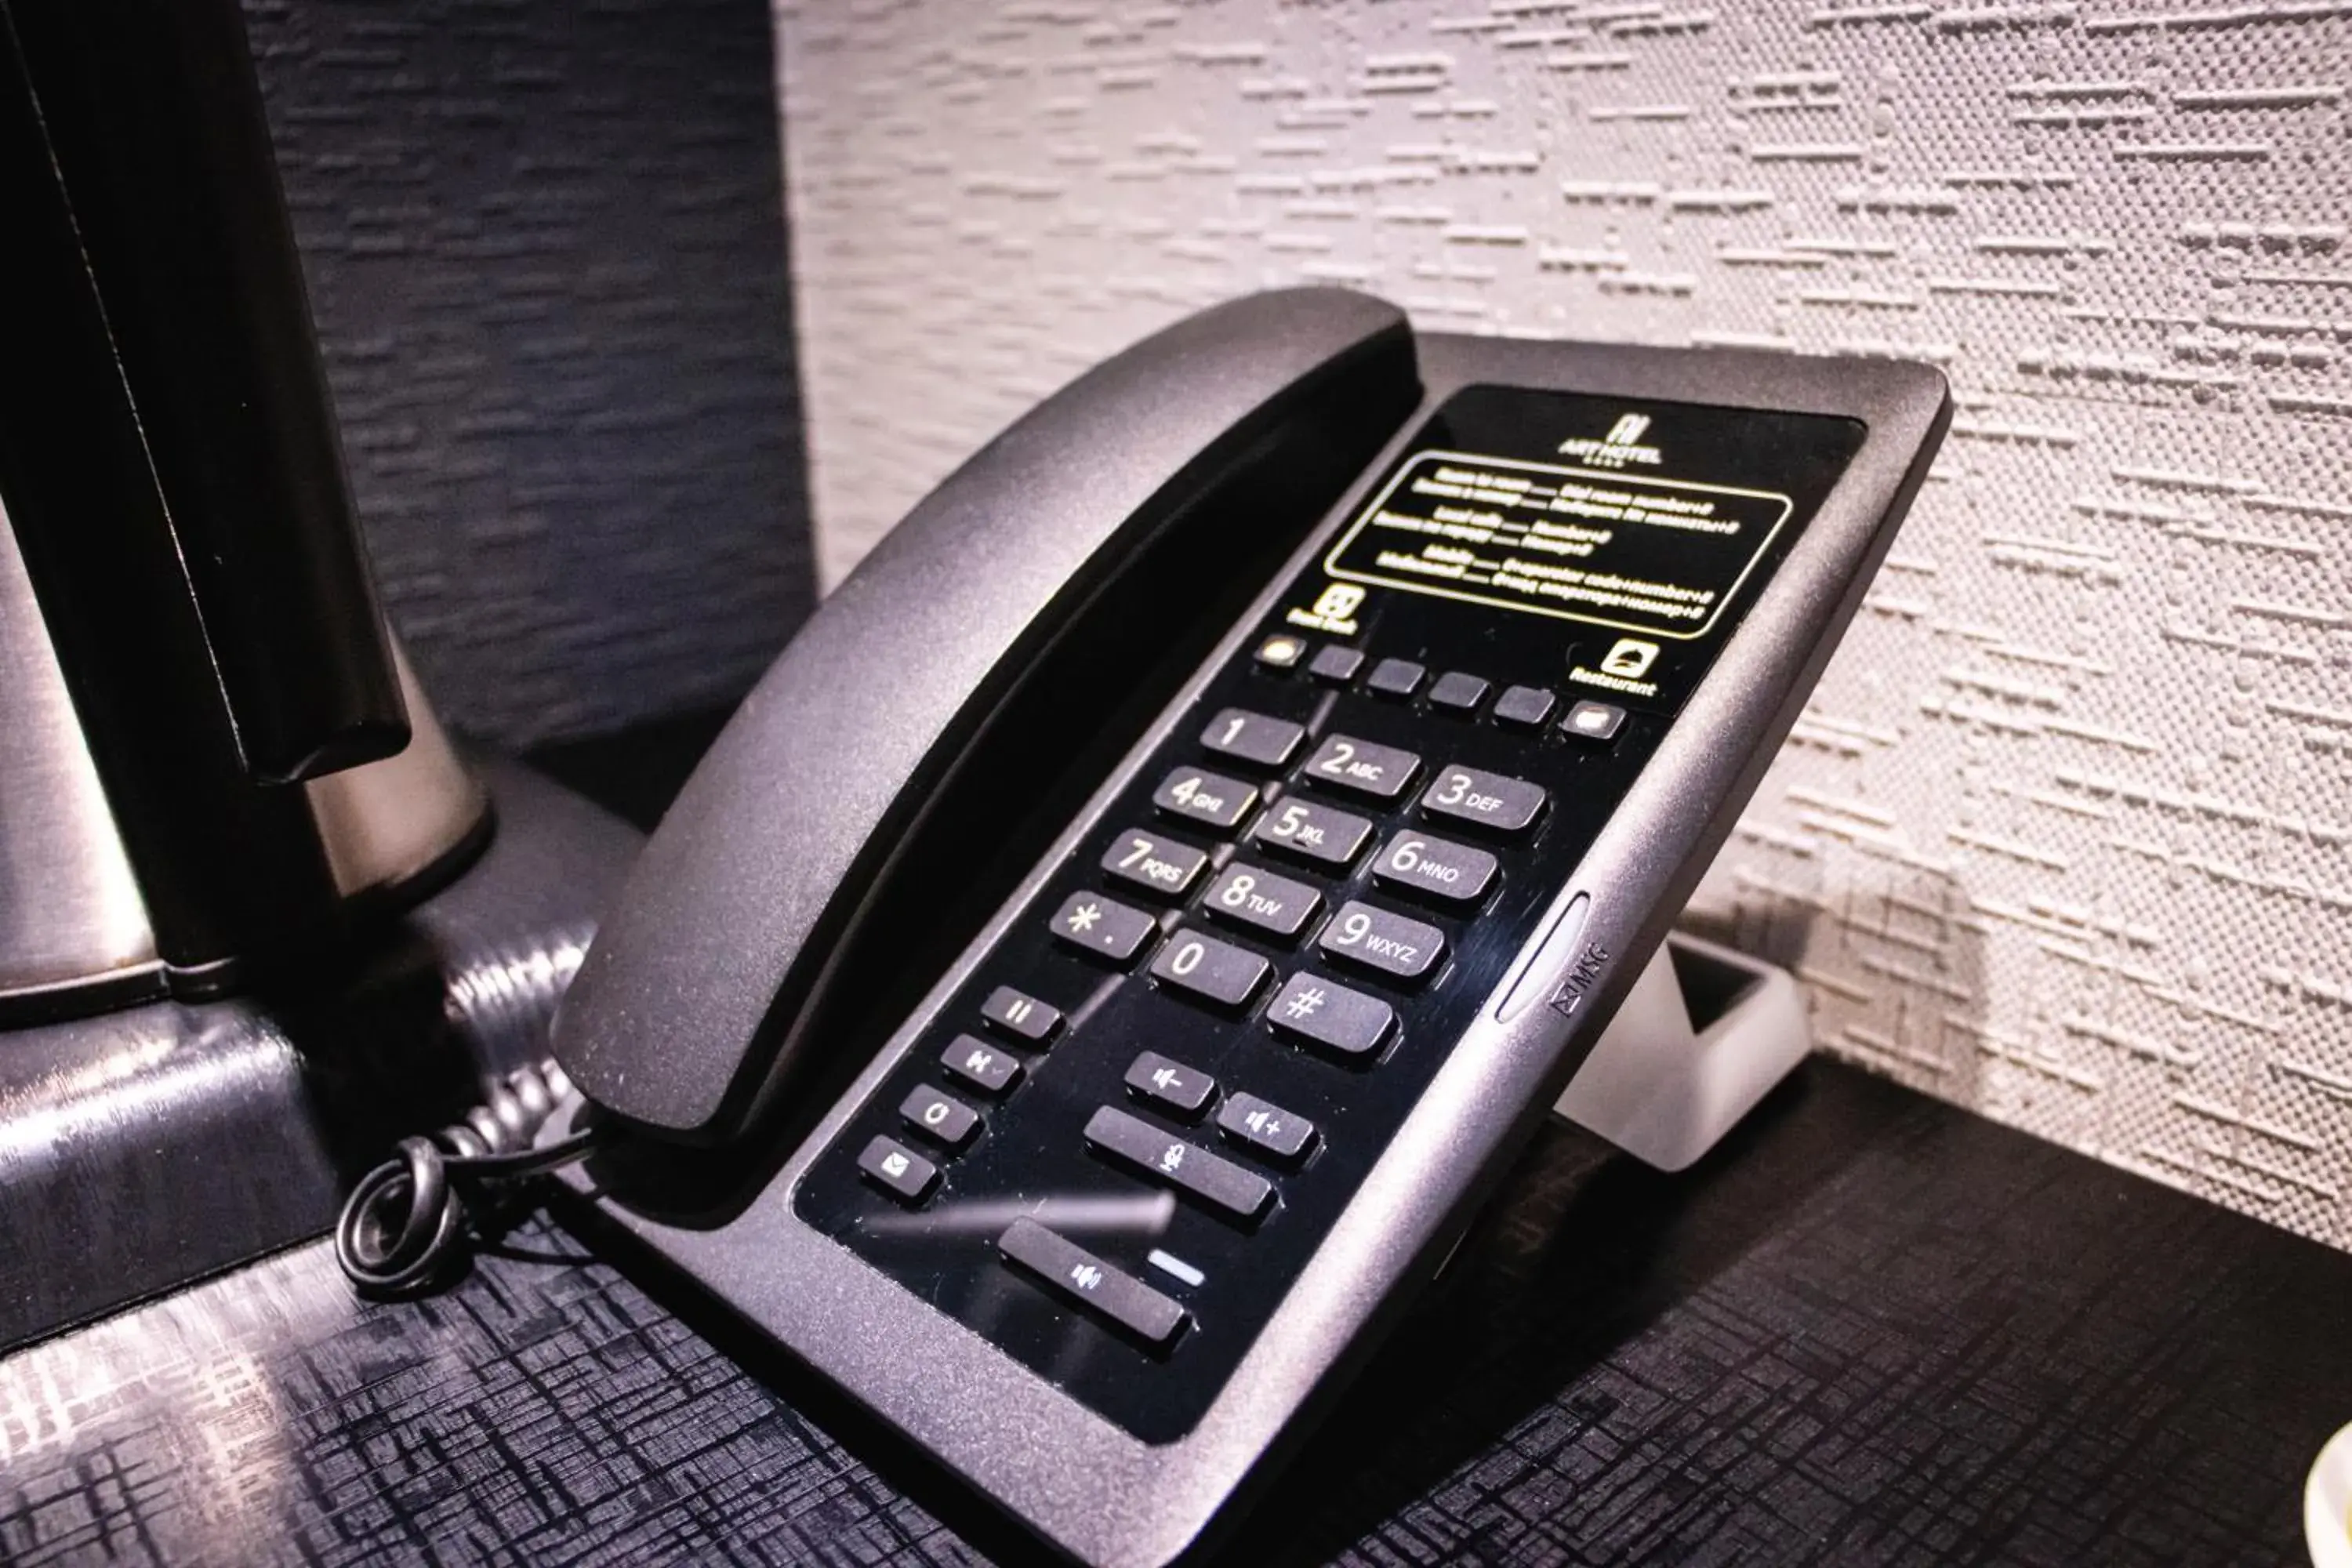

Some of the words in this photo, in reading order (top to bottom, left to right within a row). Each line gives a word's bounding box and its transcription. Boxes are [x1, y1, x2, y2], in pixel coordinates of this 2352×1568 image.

[1569, 666, 1658, 697] Restaurant
[1221, 718, 1245, 746] 1
[1321, 742, 1355, 773] 2
[1345, 760, 1383, 781] ABC
[1171, 777, 1202, 805] 4
[1436, 774, 1472, 804] 3
[1465, 793, 1504, 811] DEF
[1272, 805, 1309, 836] 5
[1295, 824, 1324, 844] JKL
[1119, 838, 1153, 868] 7
[1140, 858, 1182, 882] PQRS
[1392, 841, 1426, 871] 6
[1417, 860, 1459, 883] MNO
[1221, 875, 1254, 906] 8
[1248, 895, 1282, 916] TUV
[1337, 913, 1371, 945] 9
[1366, 934, 1417, 963] WXYZ
[1172, 942, 1205, 975] 0
[1570, 942, 1608, 991] MSG
